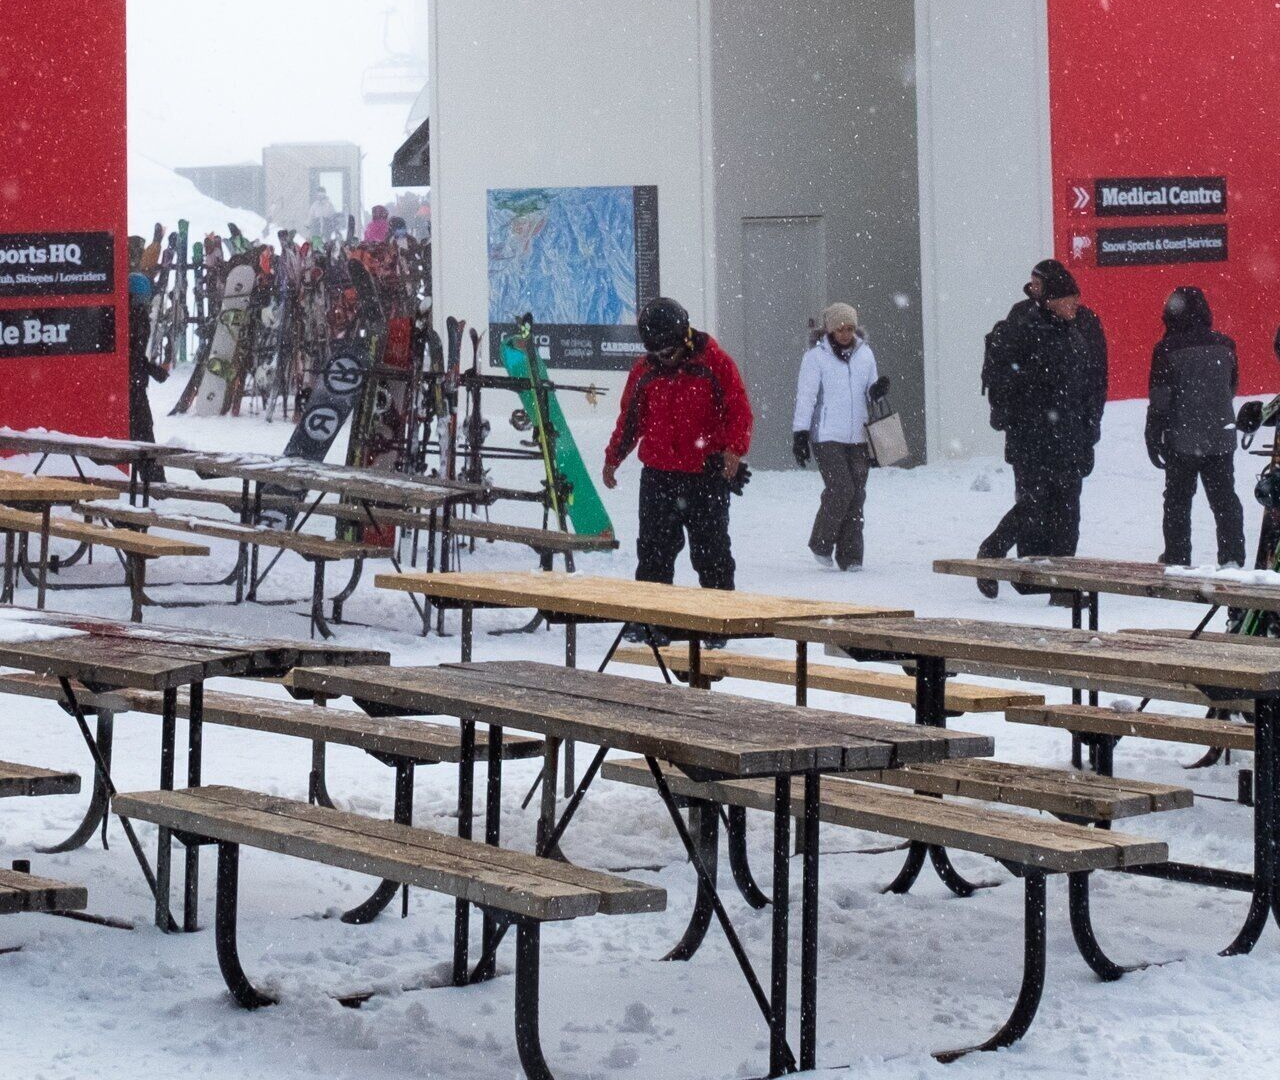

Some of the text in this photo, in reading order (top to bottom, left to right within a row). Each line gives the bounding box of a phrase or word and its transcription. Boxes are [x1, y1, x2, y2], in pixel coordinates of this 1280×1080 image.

[1101, 185, 1222, 207] Medical Centre
[49, 243, 82, 265] HQ
[1102, 237, 1222, 254] Snow Sports & Guest Services
[60, 271, 107, 283] Lowriders
[23, 320, 70, 345] Bar
